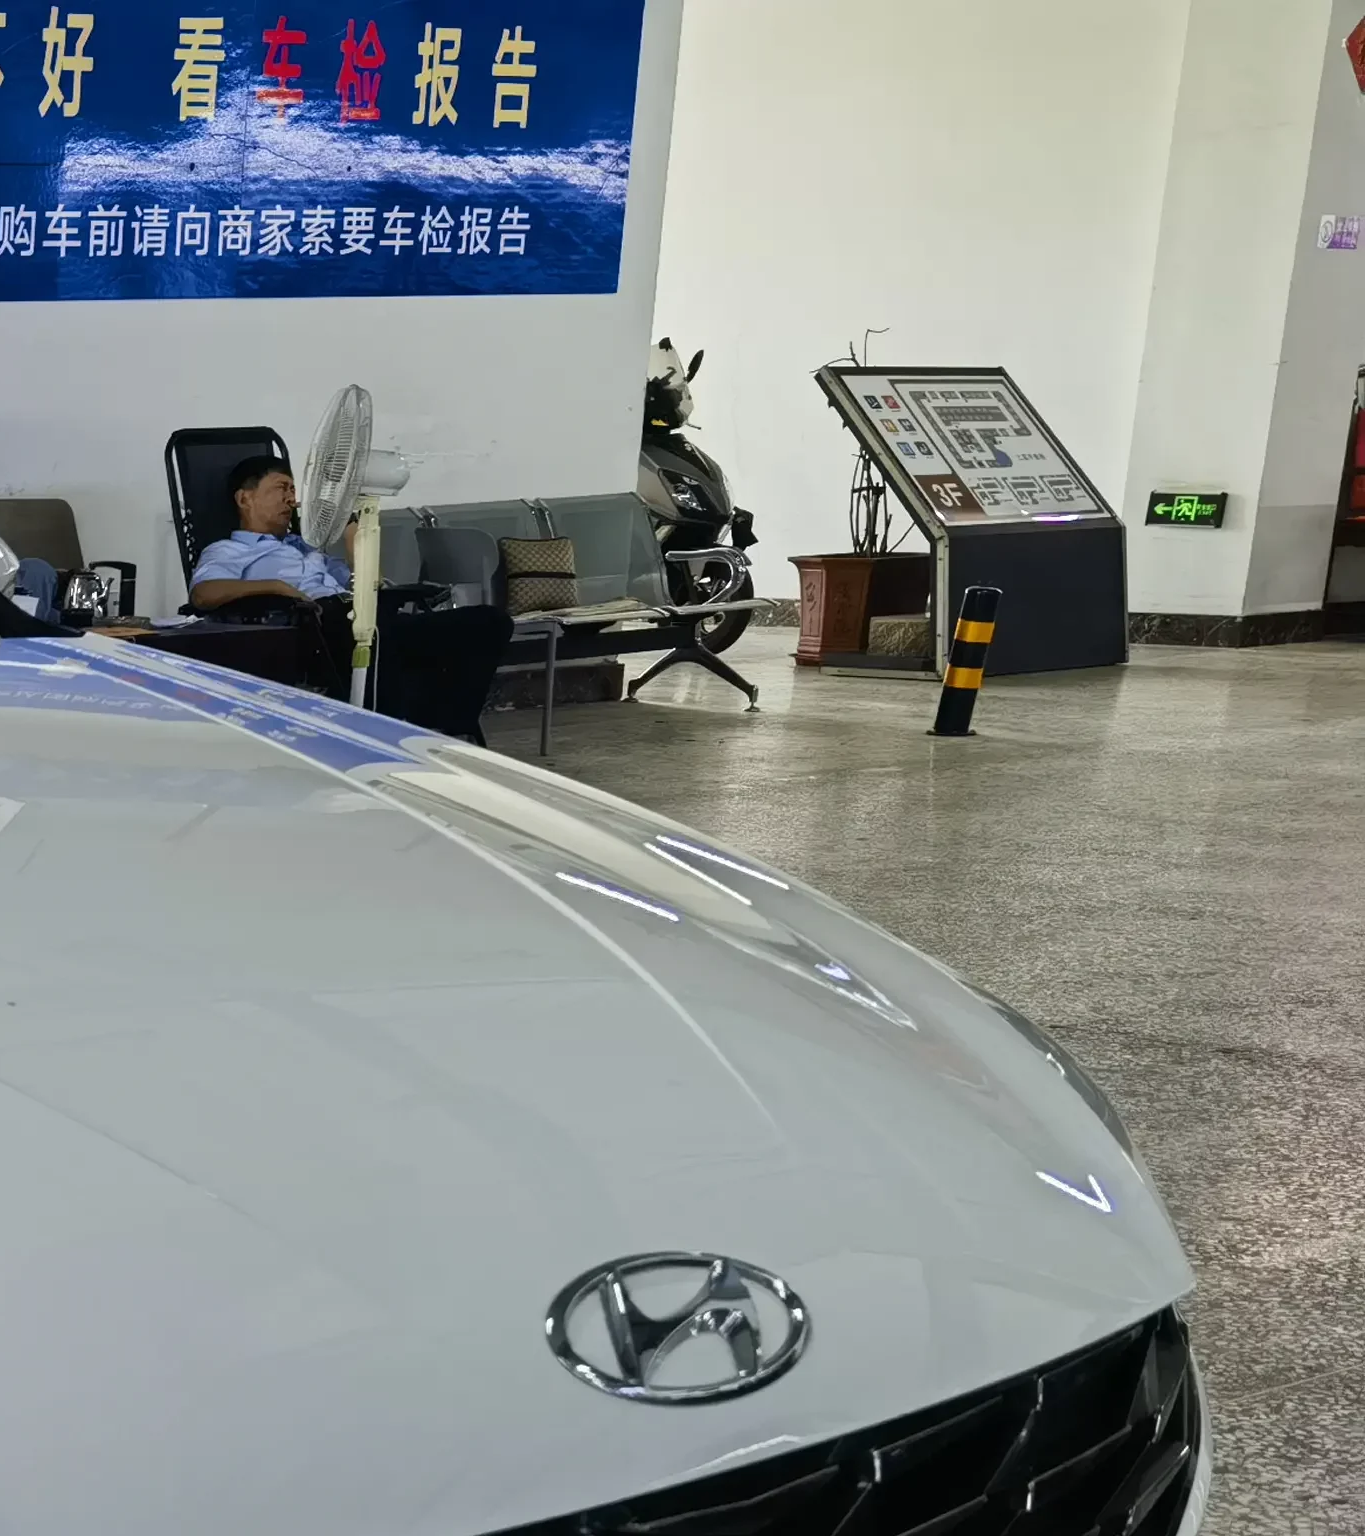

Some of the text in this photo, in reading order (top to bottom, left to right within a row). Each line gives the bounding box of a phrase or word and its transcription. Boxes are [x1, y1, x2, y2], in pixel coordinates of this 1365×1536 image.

[171, 15, 537, 128] 看车检报告
[931, 483, 963, 507] 3F
